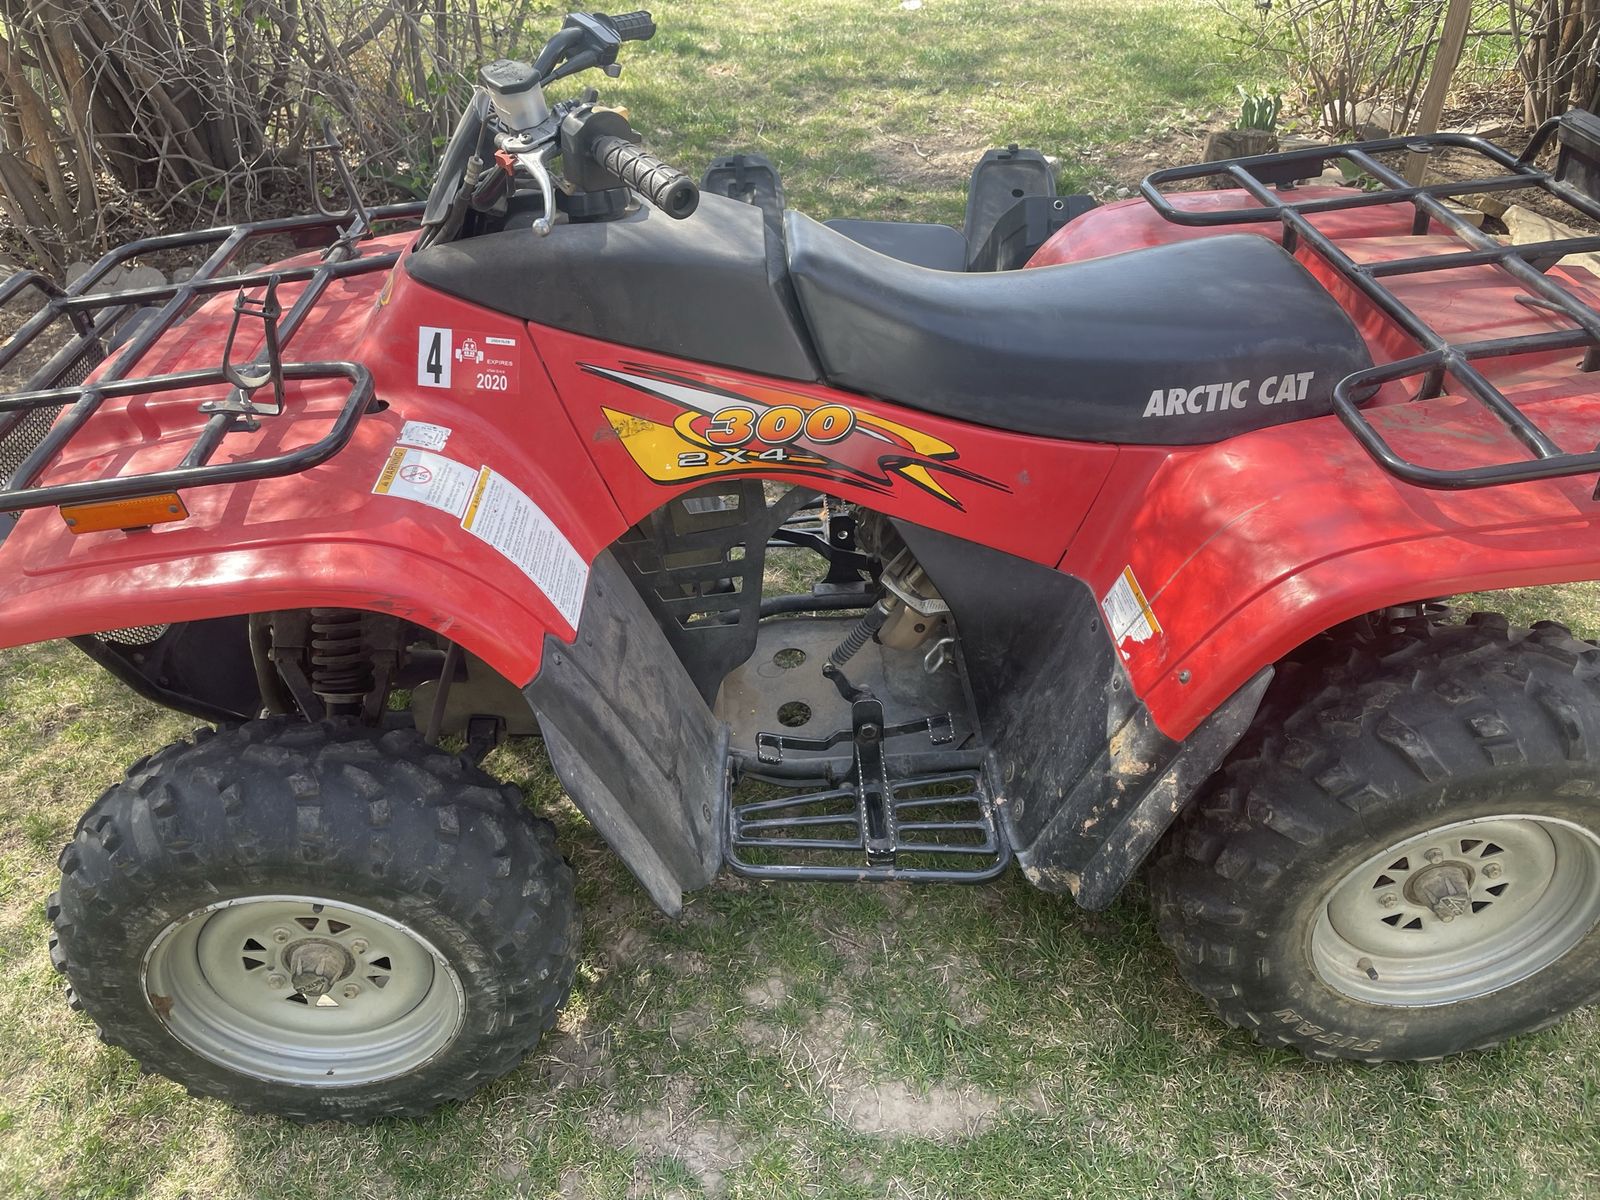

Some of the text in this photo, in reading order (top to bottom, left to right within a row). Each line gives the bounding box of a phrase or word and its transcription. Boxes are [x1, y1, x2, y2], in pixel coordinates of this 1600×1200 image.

[427, 332, 443, 384] 4
[486, 359, 513, 367] EXPIRES
[476, 373, 508, 391] 2020
[1142, 371, 1315, 418] ARCTIC CAT
[705, 404, 856, 447] 300
[384, 451, 404, 480] WARNING
[1272, 1008, 1381, 1052] TITAN
